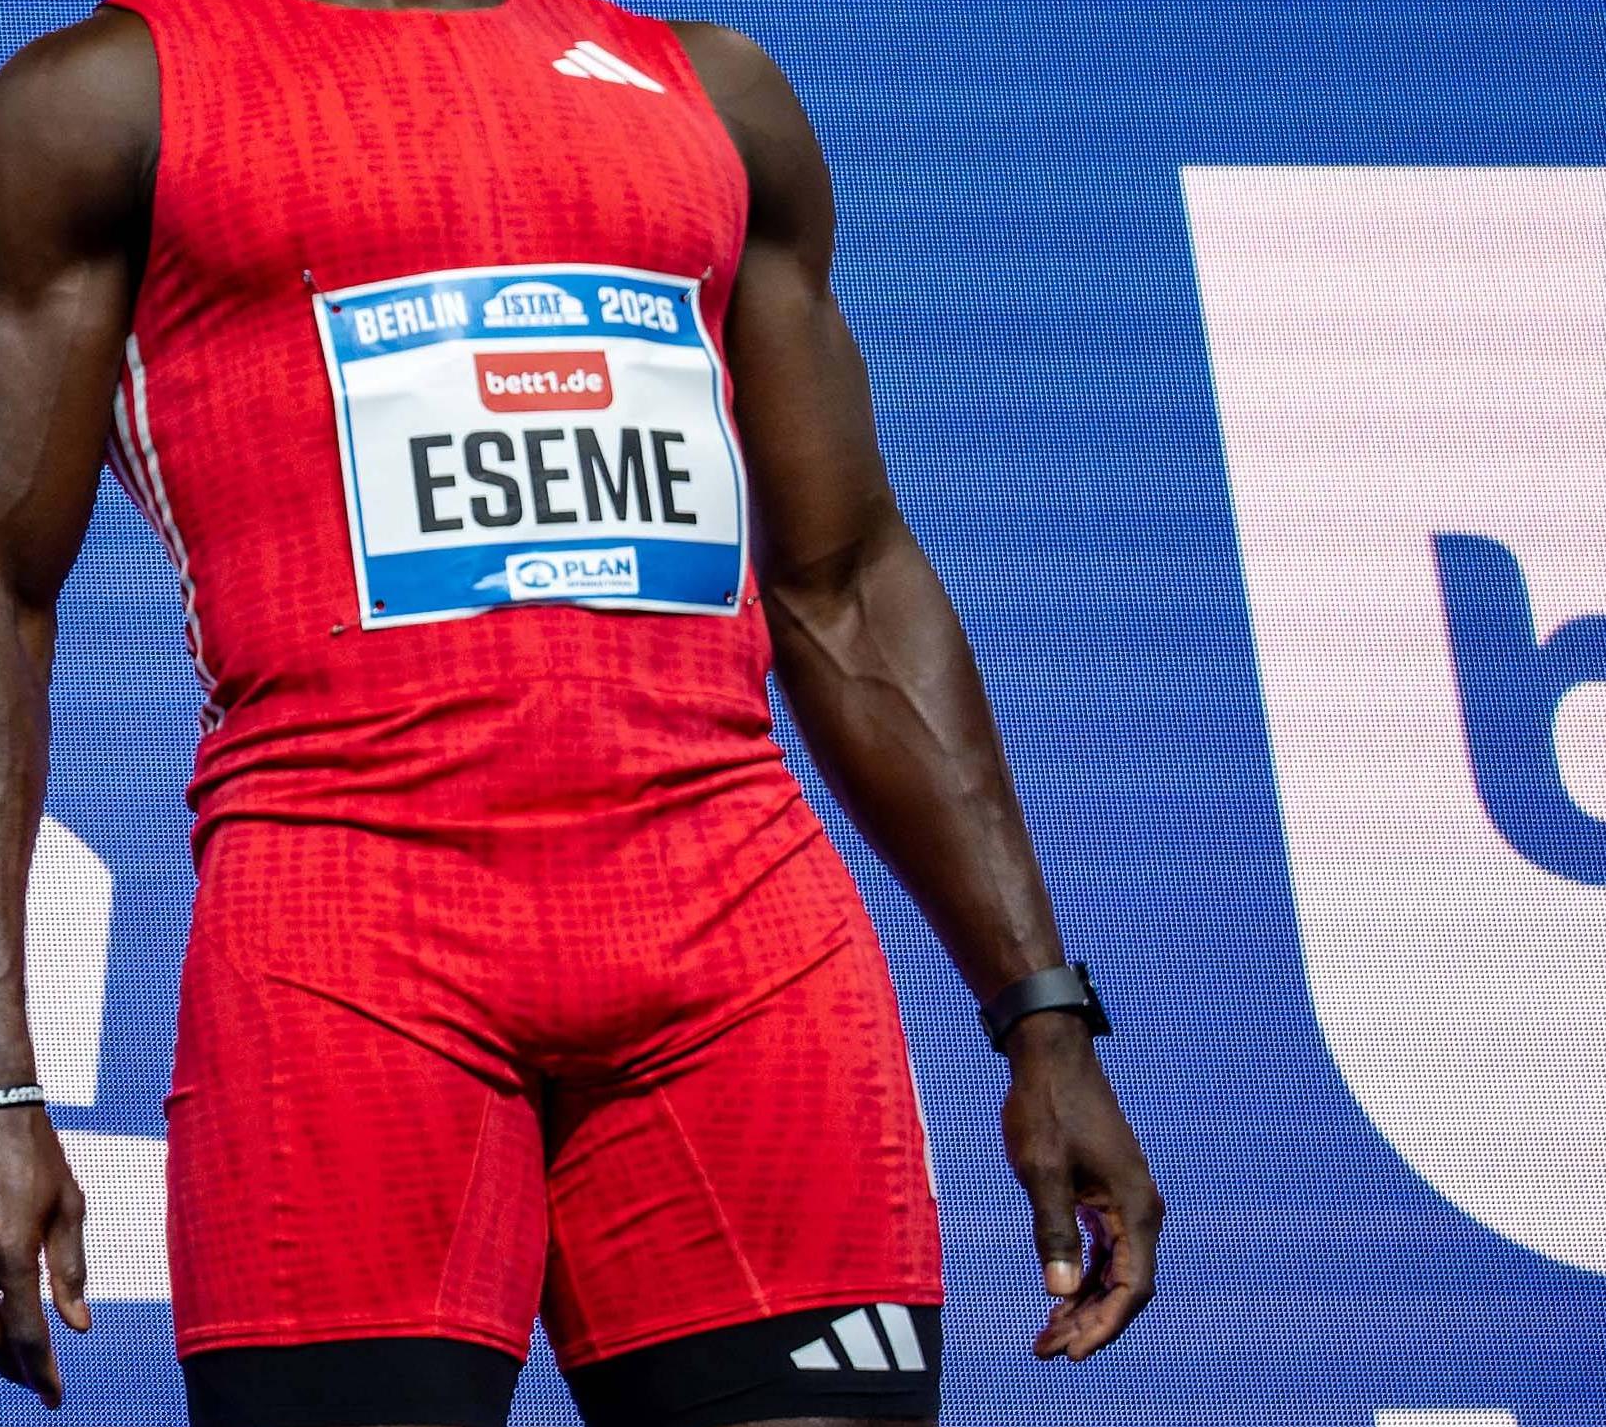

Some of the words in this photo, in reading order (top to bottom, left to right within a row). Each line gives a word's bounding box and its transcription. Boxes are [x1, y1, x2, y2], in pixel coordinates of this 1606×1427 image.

[355, 289, 469, 345] BERLIN
[501, 293, 561, 316] ISTAF
[598, 285, 679, 334] 2026
[486, 362, 605, 396] bett1.de
[409, 428, 698, 534] ESEME
[564, 557, 632, 578] PLAN
